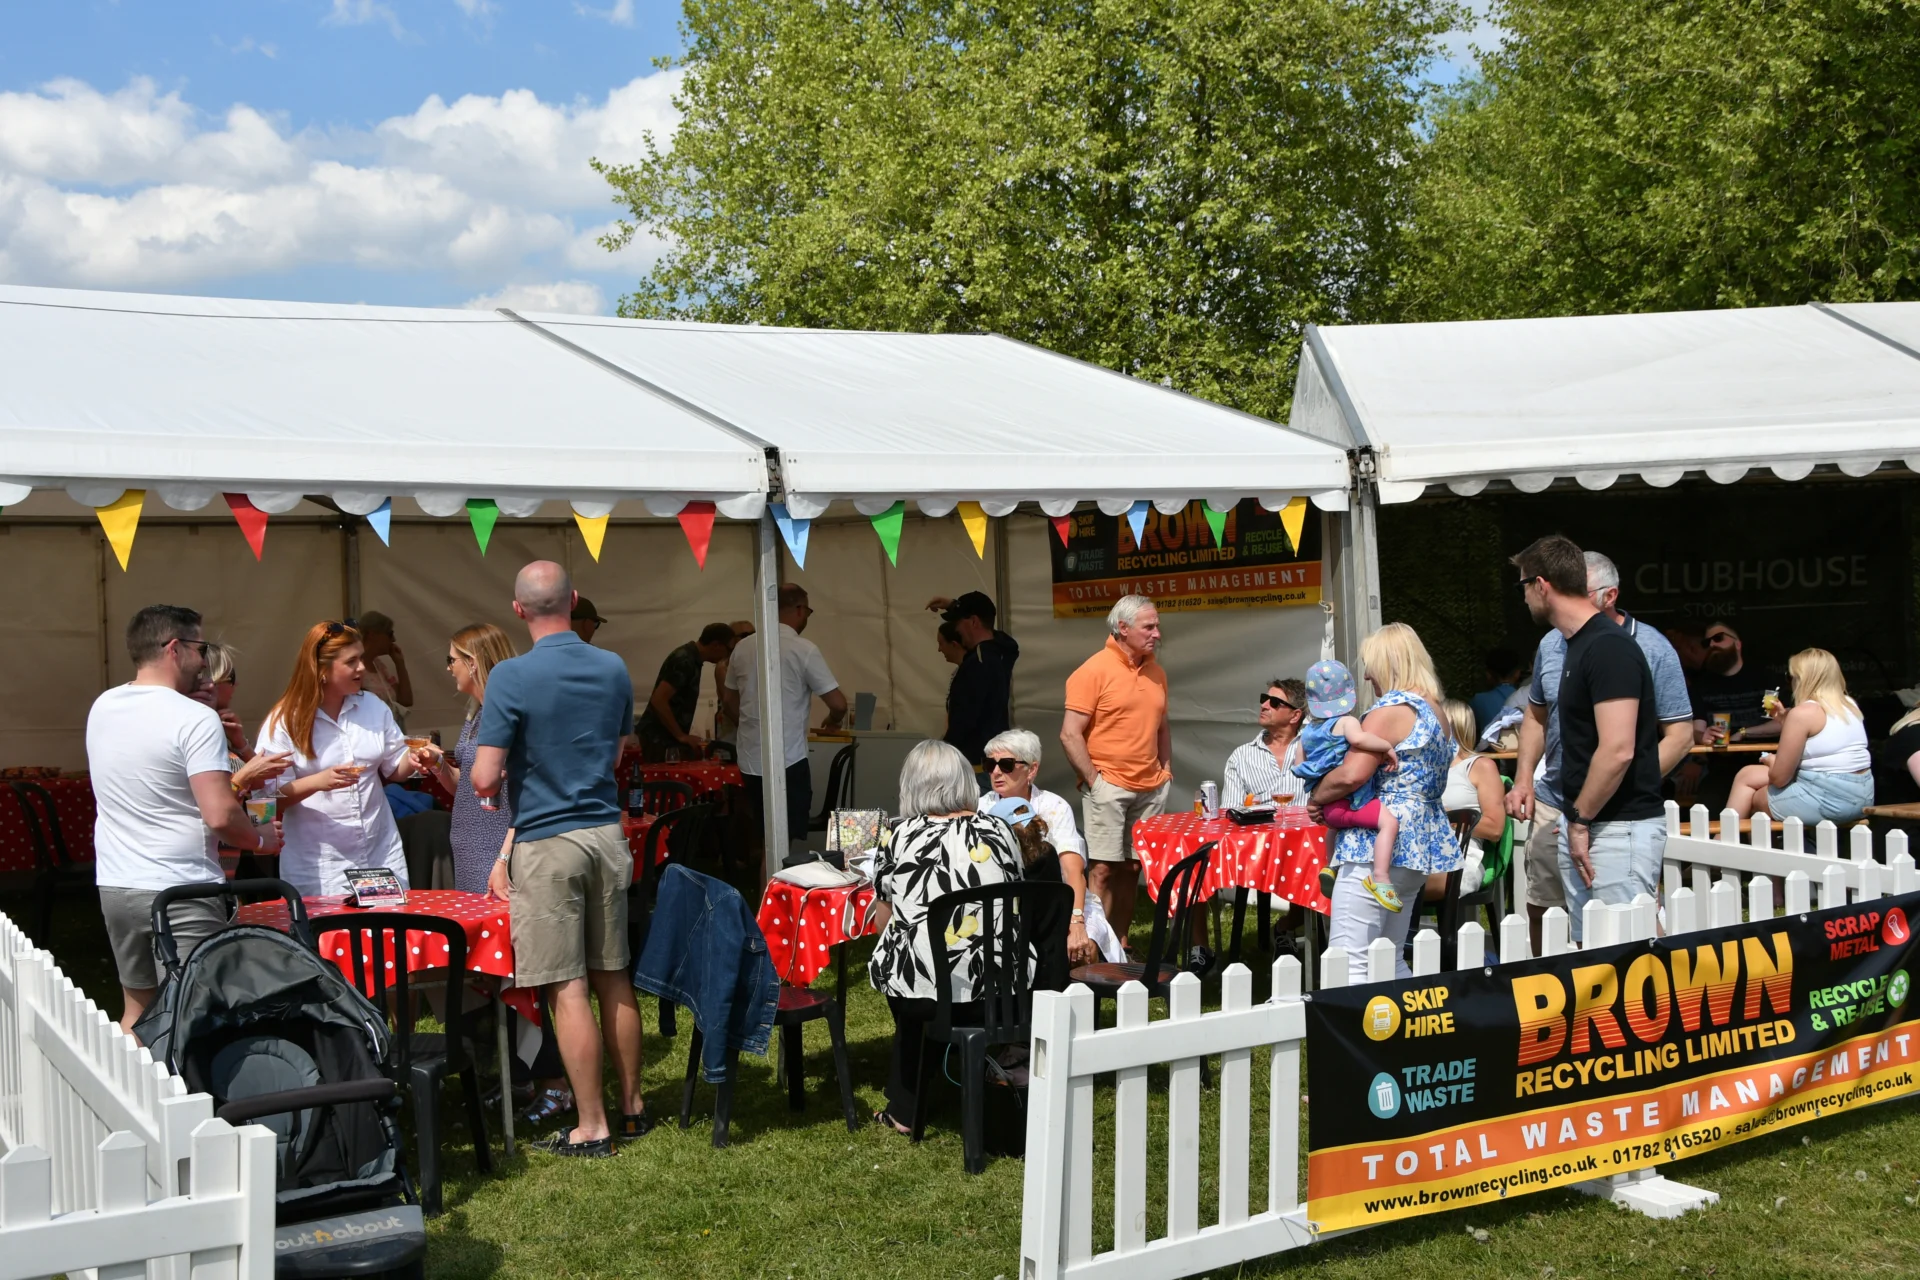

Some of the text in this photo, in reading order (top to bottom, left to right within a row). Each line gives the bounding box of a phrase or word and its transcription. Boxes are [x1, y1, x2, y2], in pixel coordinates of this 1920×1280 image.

[1079, 514, 1094, 526] SKIP
[1079, 526, 1095, 537] HIRE
[1242, 542, 1283, 556] & RE-USE
[1245, 529, 1282, 543] RECYCLE
[1078, 561, 1104, 572] WASTE
[1080, 548, 1105, 559] TRADE
[1117, 546, 1236, 571] RECYCLING LIMITED
[1069, 569, 1306, 599] TOTAL WASTE MANAGEMENT
[1634, 555, 1868, 594] CLUBHOUSE
[1683, 601, 1737, 618] STOKE
[1823, 911, 1880, 940] SCRAP
[1830, 934, 1880, 961] METAL
[1402, 986, 1449, 1012] SKIP
[1511, 931, 1794, 1067] BROWN
[1809, 974, 1889, 1010] RECYCLE
[1404, 1012, 1456, 1039] HIRE
[1810, 995, 1885, 1031] & RE-USE
[1402, 1058, 1477, 1087] TRADE
[1515, 1019, 1796, 1098] RECYCLING LIMITED
[1361, 1034, 1911, 1180] TOTAL WASTE MANAGEMENT
[1405, 1082, 1475, 1114] WASTE
[1364, 1154, 1598, 1214] www.brownrecycling.co.uk
[1612, 1141, 1660, 1165] 01782
[1664, 1126, 1721, 1153] 816520
[1734, 1071, 1913, 1136] sales@brownrecycling.co.uk
